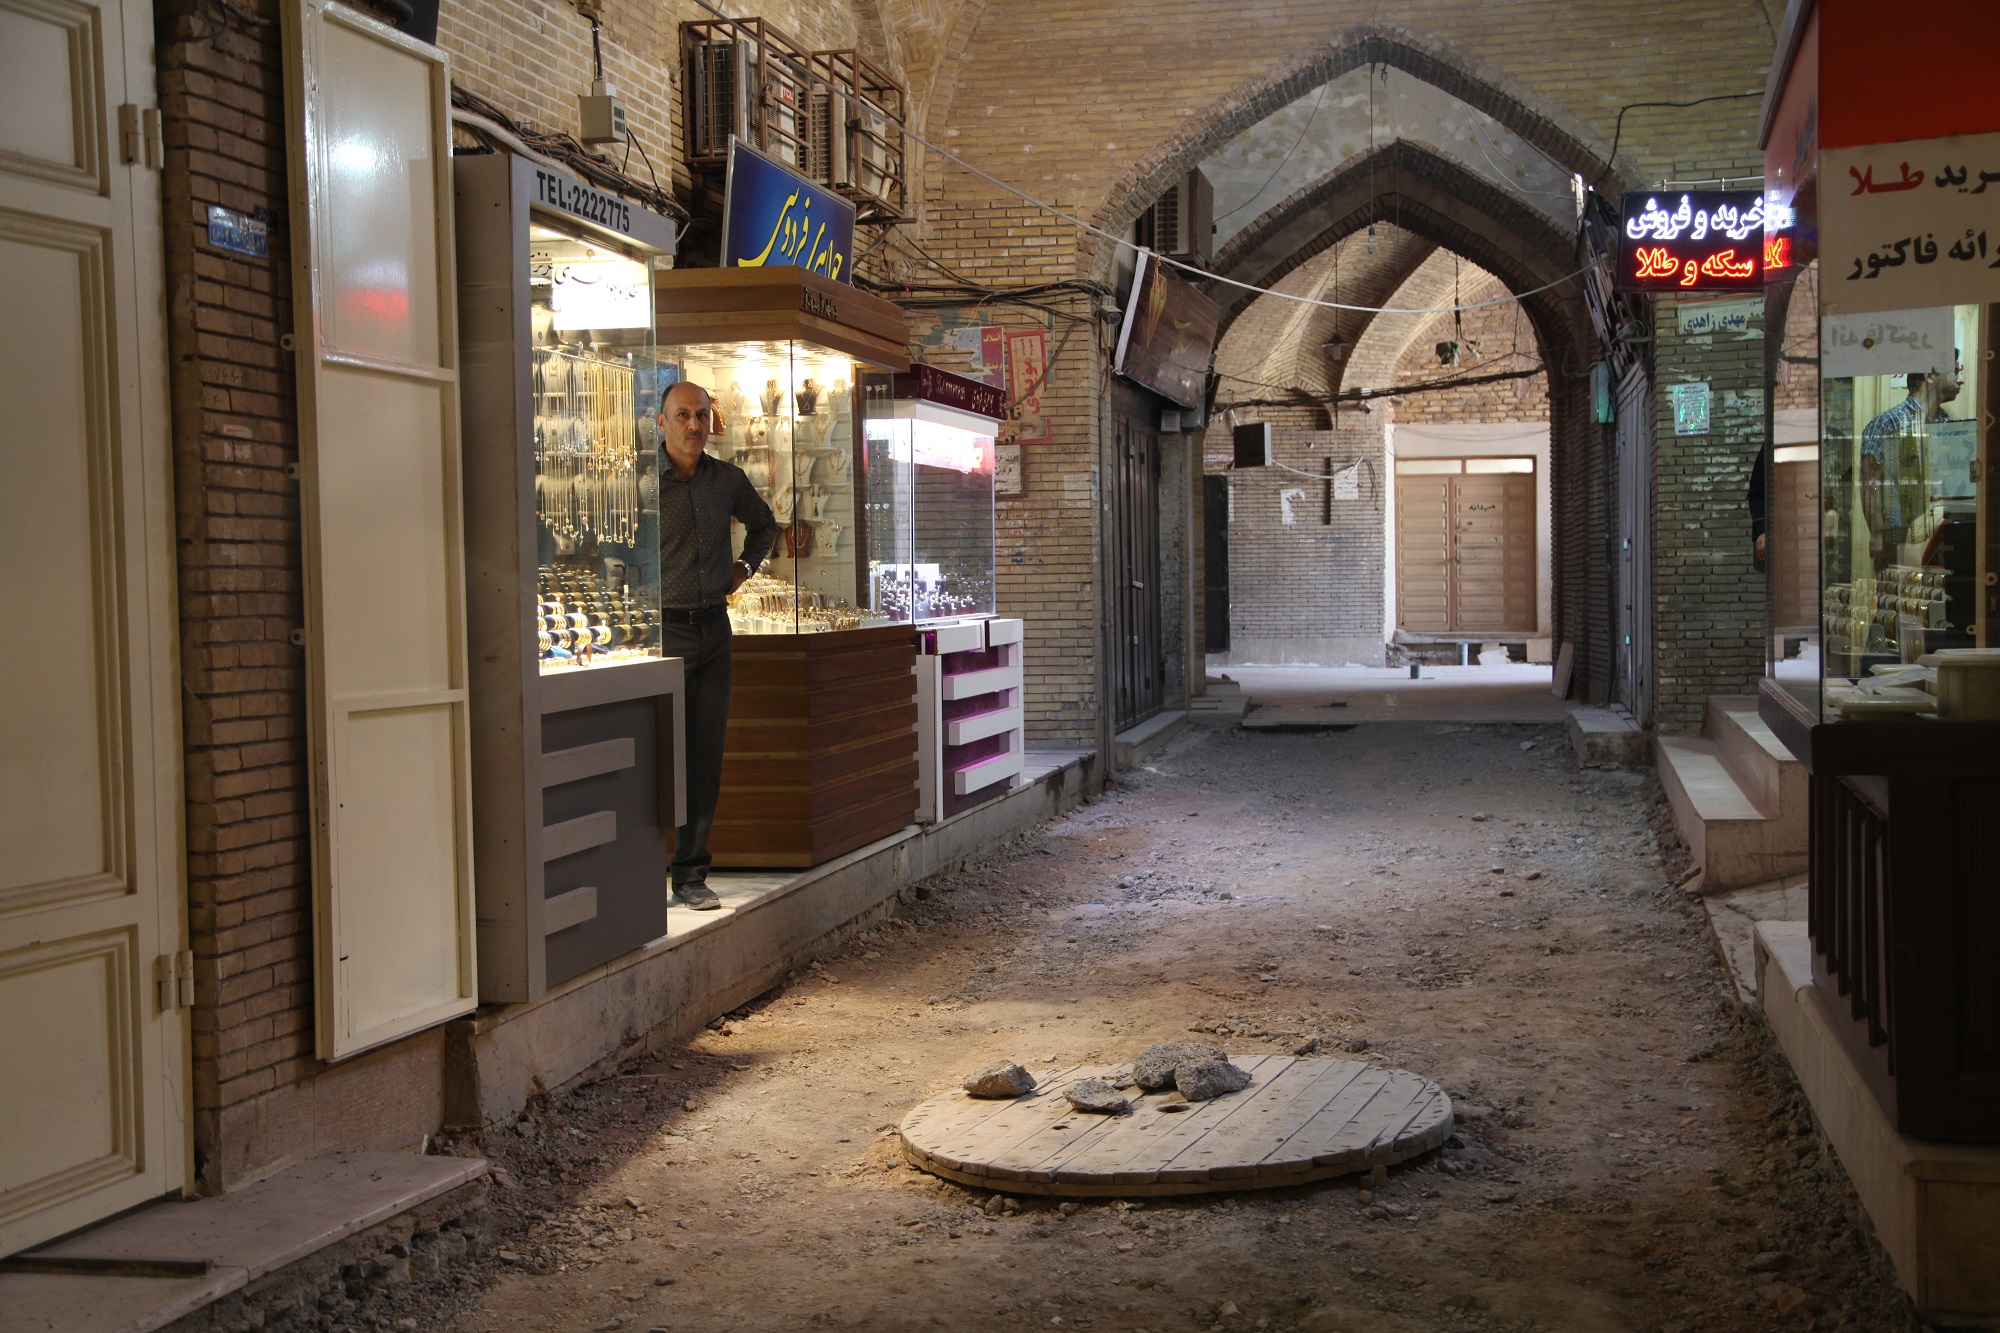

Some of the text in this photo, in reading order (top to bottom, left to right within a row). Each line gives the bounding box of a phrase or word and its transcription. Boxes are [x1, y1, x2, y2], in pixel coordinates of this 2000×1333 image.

[783, 87, 794, 101] TCL
[1848, 161, 2000, 196] رید طلا
[537, 170, 630, 233] TEL:2222775
[1626, 194, 1692, 239] فروش
[1690, 209, 1708, 240] و
[1711, 196, 1765, 240] خرید
[1635, 247, 1680, 278] طلا
[1701, 249, 1754, 278] سکه
[1846, 228, 2000, 281] رائه فاکتور
[1680, 260, 1698, 286] و
[1718, 311, 1746, 331] مهدی
[1468, 502, 1496, 511] مردانه
